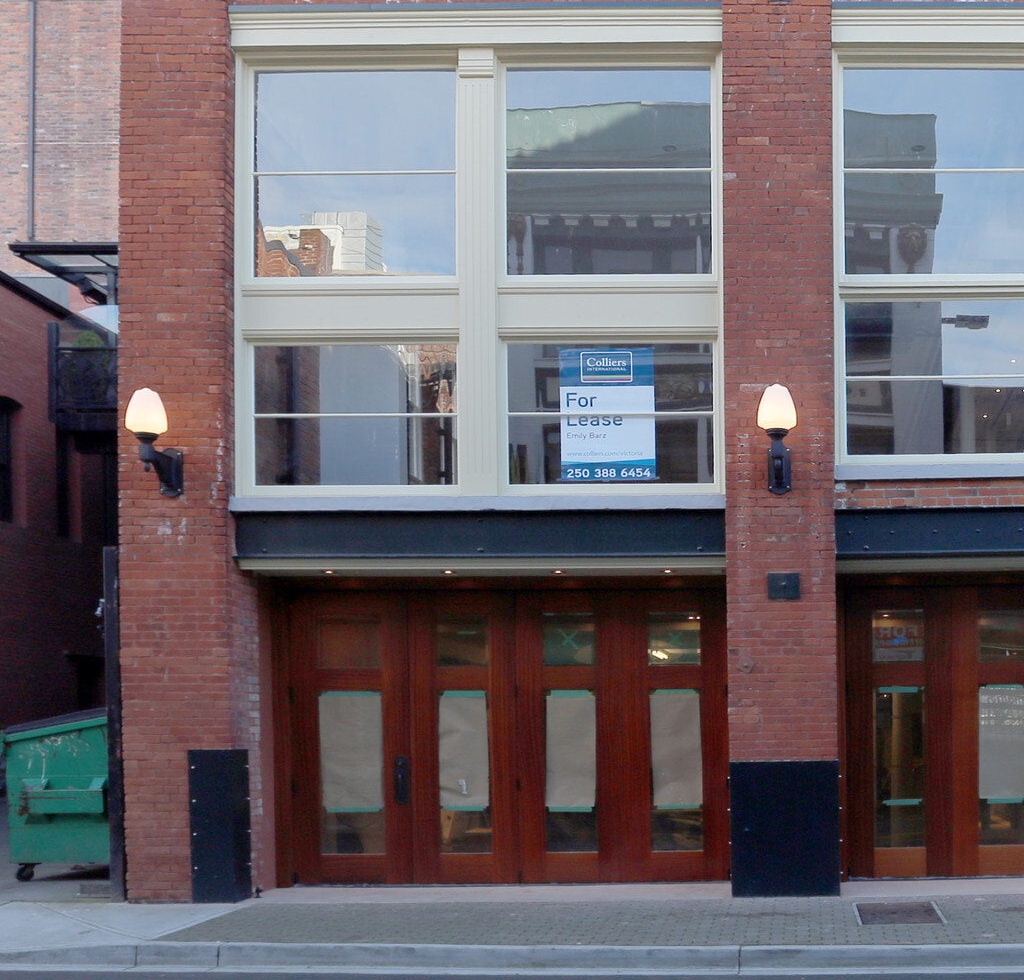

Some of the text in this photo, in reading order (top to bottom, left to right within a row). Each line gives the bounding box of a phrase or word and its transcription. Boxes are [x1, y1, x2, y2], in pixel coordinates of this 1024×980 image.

[586, 357, 627, 367] Colliers
[566, 392, 597, 407] For
[567, 414, 623, 426] Lease
[566, 432, 587, 440] Emily
[567, 467, 651, 478] 250 388 6454
